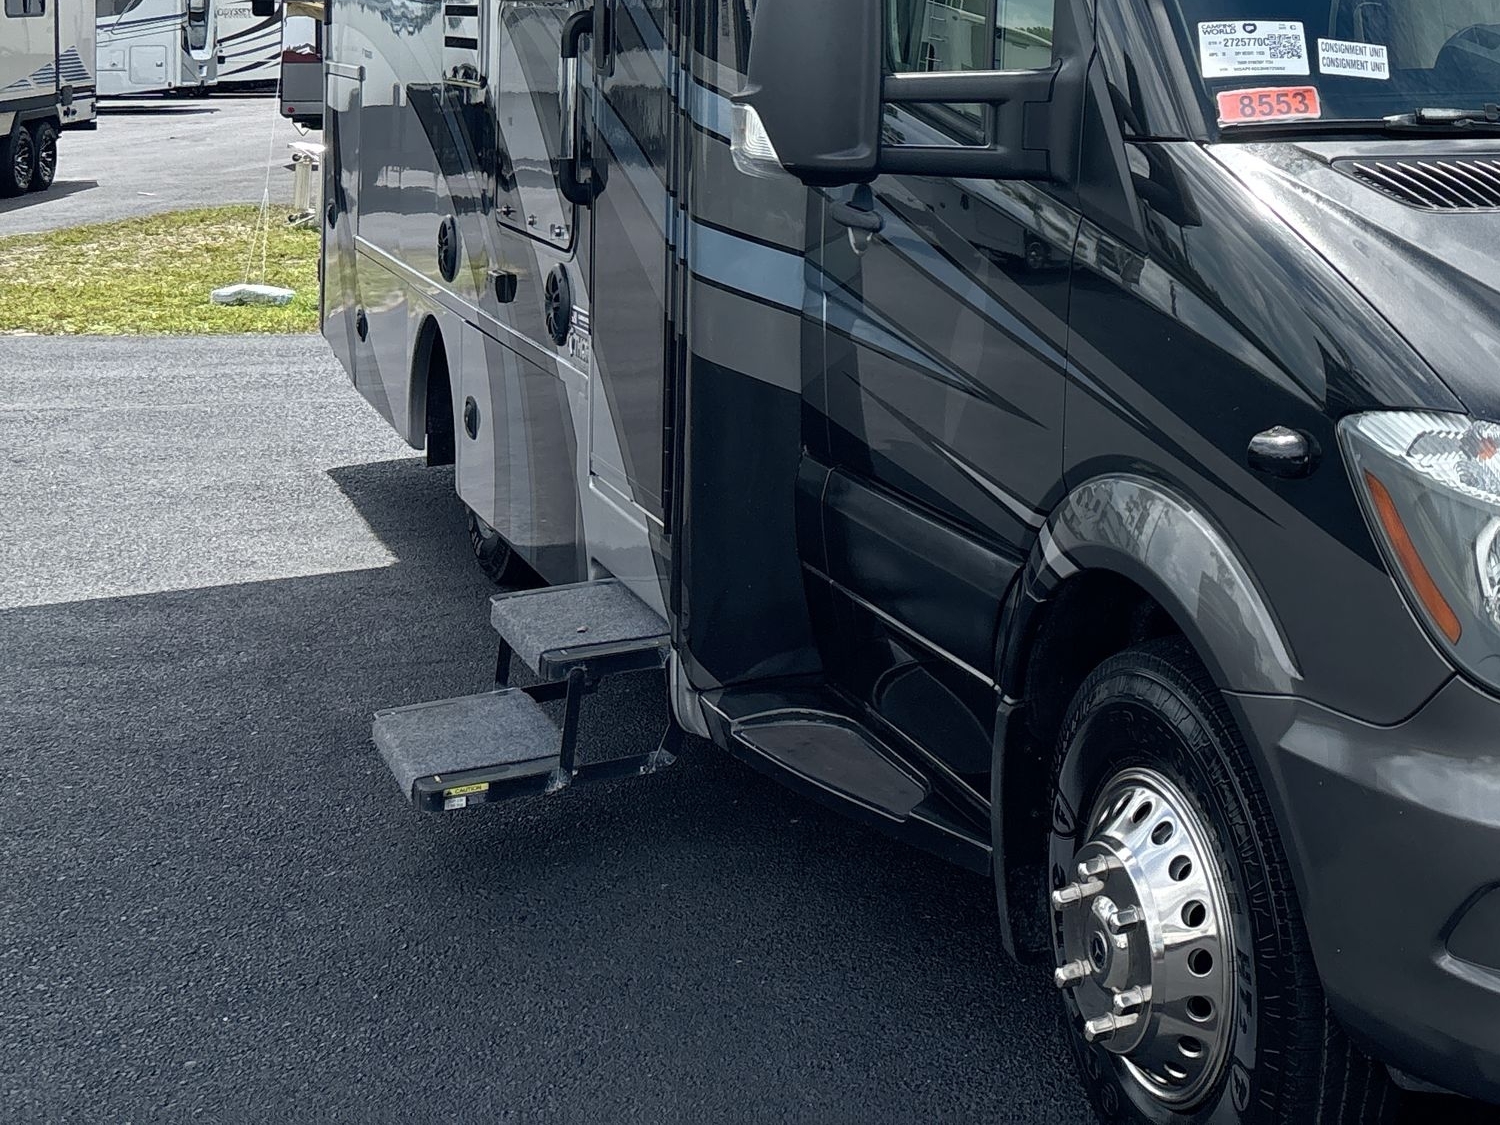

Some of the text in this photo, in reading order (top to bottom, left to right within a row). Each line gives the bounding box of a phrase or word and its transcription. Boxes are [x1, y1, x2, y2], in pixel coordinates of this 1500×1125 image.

[217, 7, 252, 17] ODYSSEY
[1223, 36, 1269, 48] 2725770C
[1321, 41, 1385, 58] CONSIGNMENT UNIT
[1322, 56, 1386, 73] CONSIGNMENT UNIT
[1240, 92, 1309, 118] 8553
